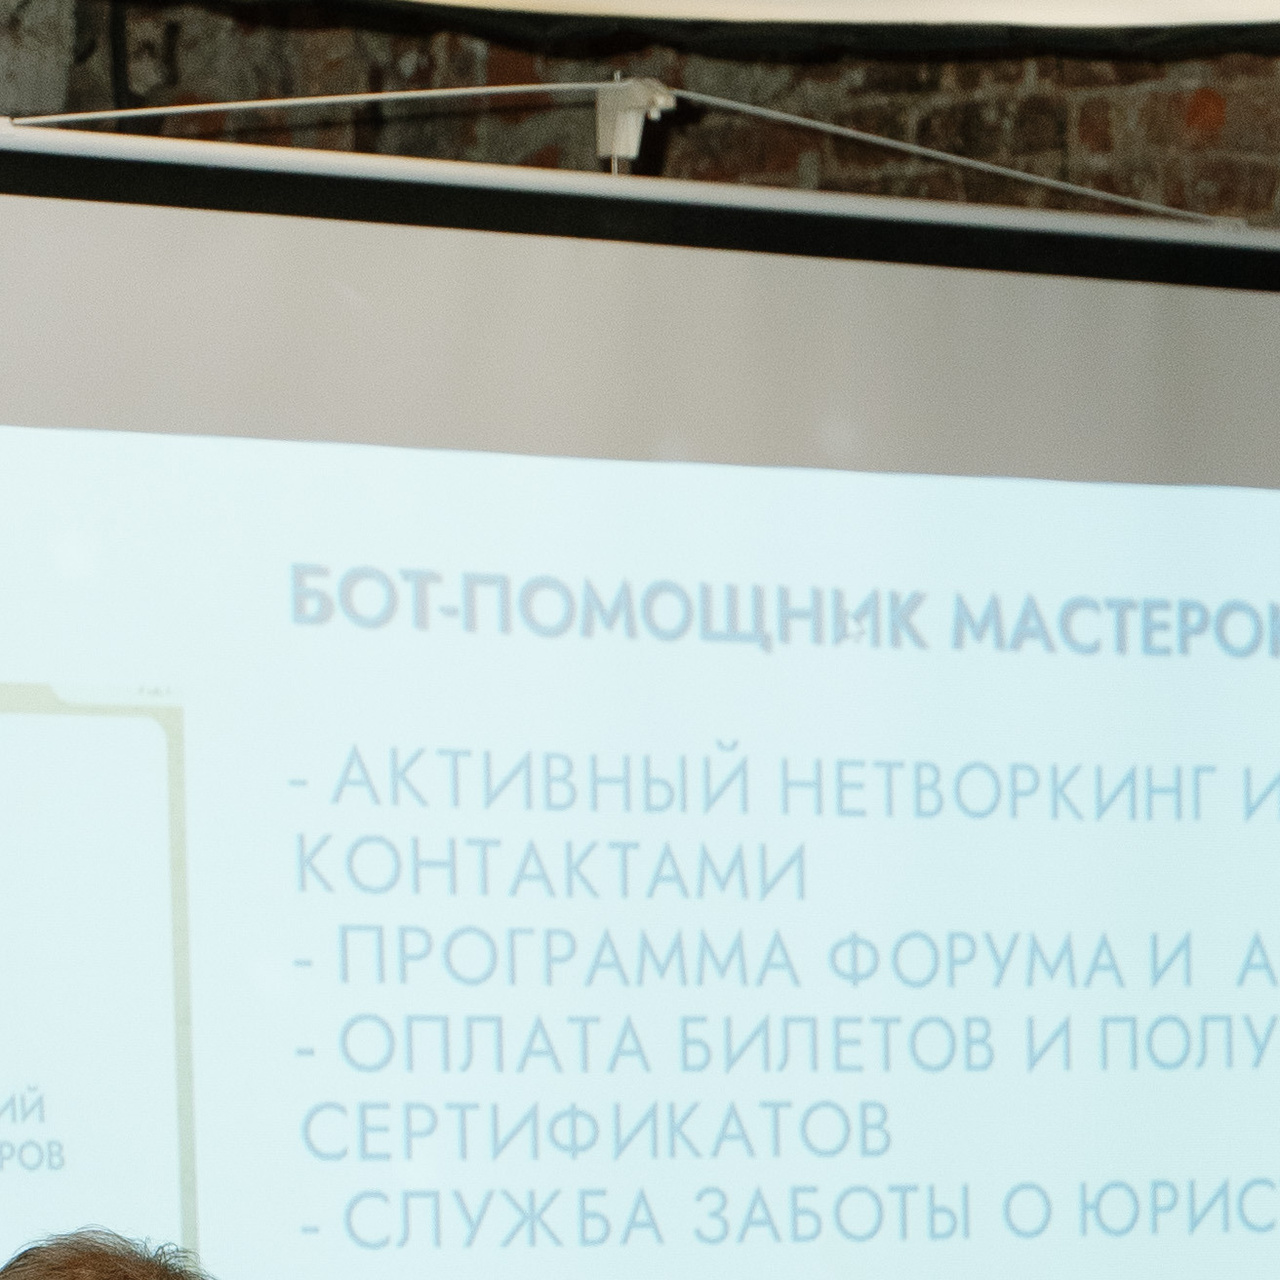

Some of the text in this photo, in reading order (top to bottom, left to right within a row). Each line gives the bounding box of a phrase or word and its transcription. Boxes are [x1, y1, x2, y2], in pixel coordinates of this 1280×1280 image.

[289, 562, 931, 655] БОТ-ПОМОЩНИК
[329, 738, 750, 816] АКТИВНЫЙ
[779, 757, 1219, 824] НЕТВОРКИНГ
[295, 832, 807, 903] КОНТАКТАМИ
[337, 923, 803, 989] ПРОГРАММА
[827, 929, 1127, 990] ФОРУМА
[1148, 931, 1193, 988] И
[337, 1012, 653, 1075] ОПЛАТА
[678, 1014, 996, 1075] БИЛЕТОВ
[1025, 1015, 1072, 1073] И
[299, 1098, 893, 1163] СЕРТИФИКАТОВ
[342, 1186, 666, 1252] СЛУЖБА
[692, 1182, 972, 1247] ЗАБОТЫ
[1000, 1180, 1054, 1241] О
